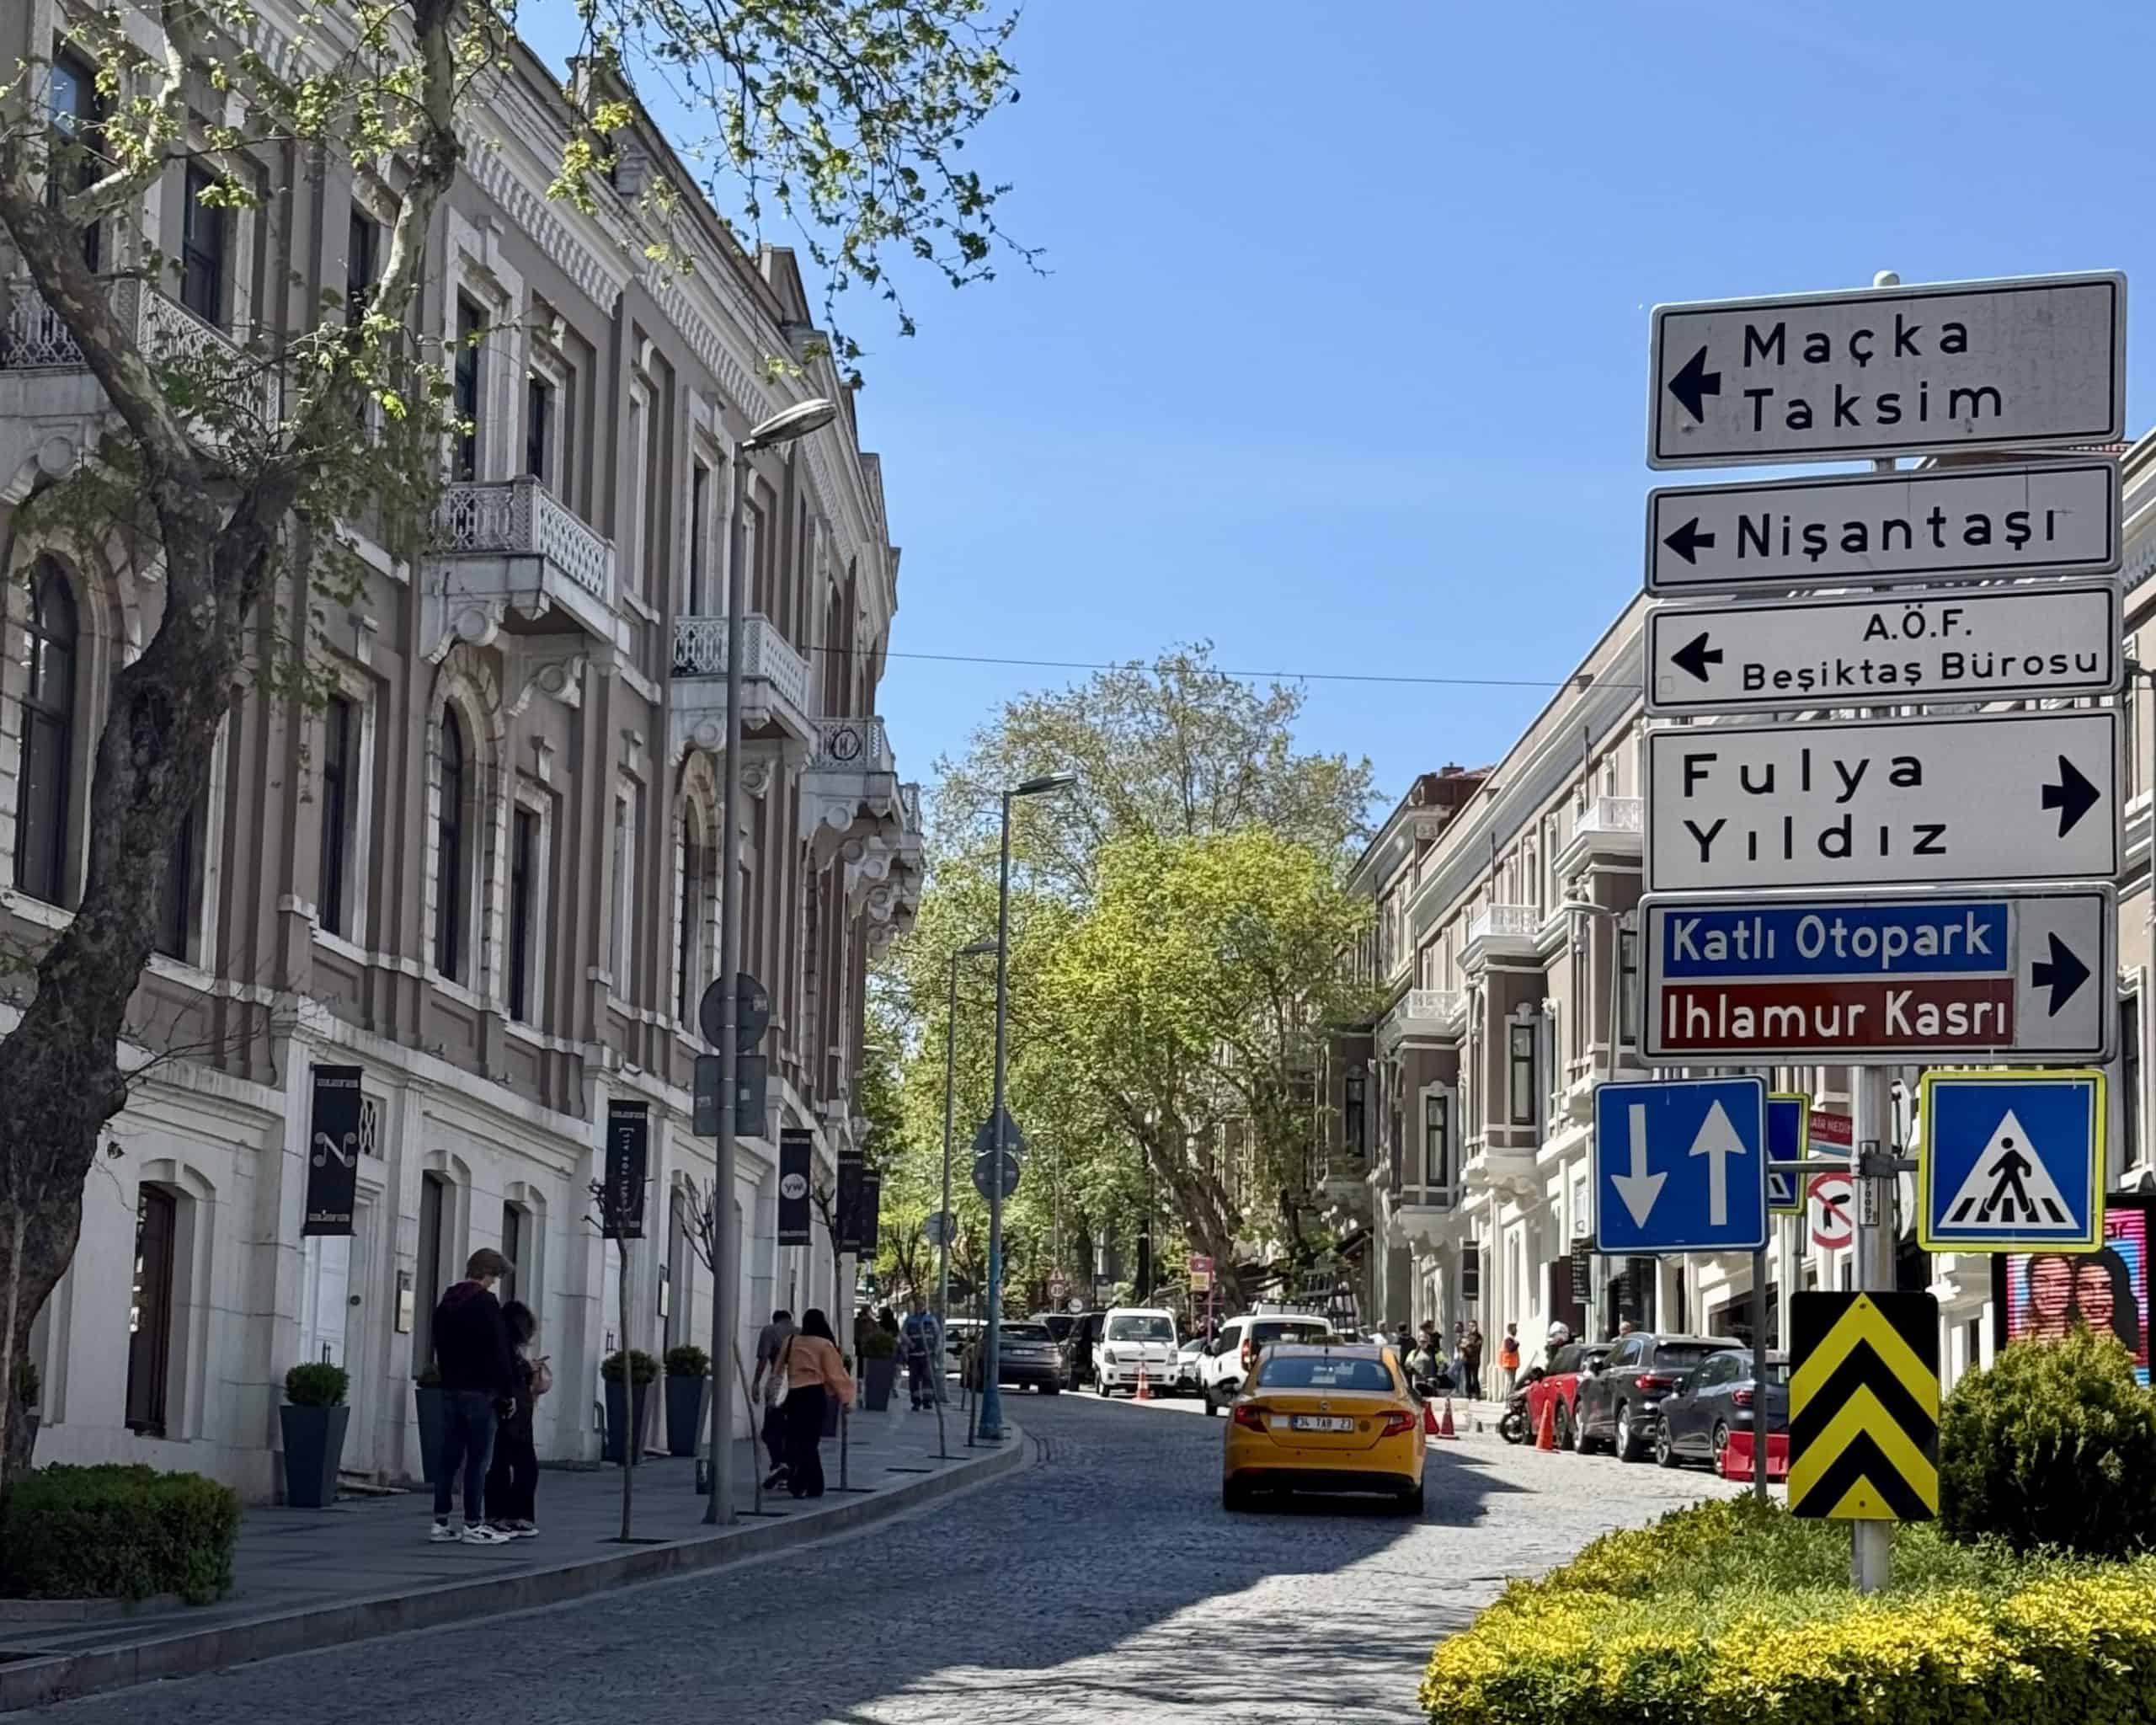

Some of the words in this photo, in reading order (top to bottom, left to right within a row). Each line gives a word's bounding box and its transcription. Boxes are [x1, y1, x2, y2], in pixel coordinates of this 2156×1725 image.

[1744, 313, 1968, 368] Maçka
[1744, 381, 2002, 432] Taksim
[1737, 507, 2055, 563] Nişantaşı
[1864, 604, 1972, 642] A.Ö.F.
[1743, 658, 1923, 692] Beşiktaş
[1941, 651, 2097, 680] Bürosu
[1684, 748, 1922, 804] Fulya
[1684, 813, 1946, 863] Yıldız
[1673, 916, 1774, 961] Katlı
[1796, 911, 1993, 969] Otopark
[1668, 993, 1866, 1039] Ihlamur
[1886, 990, 2004, 1036] Kasrı
